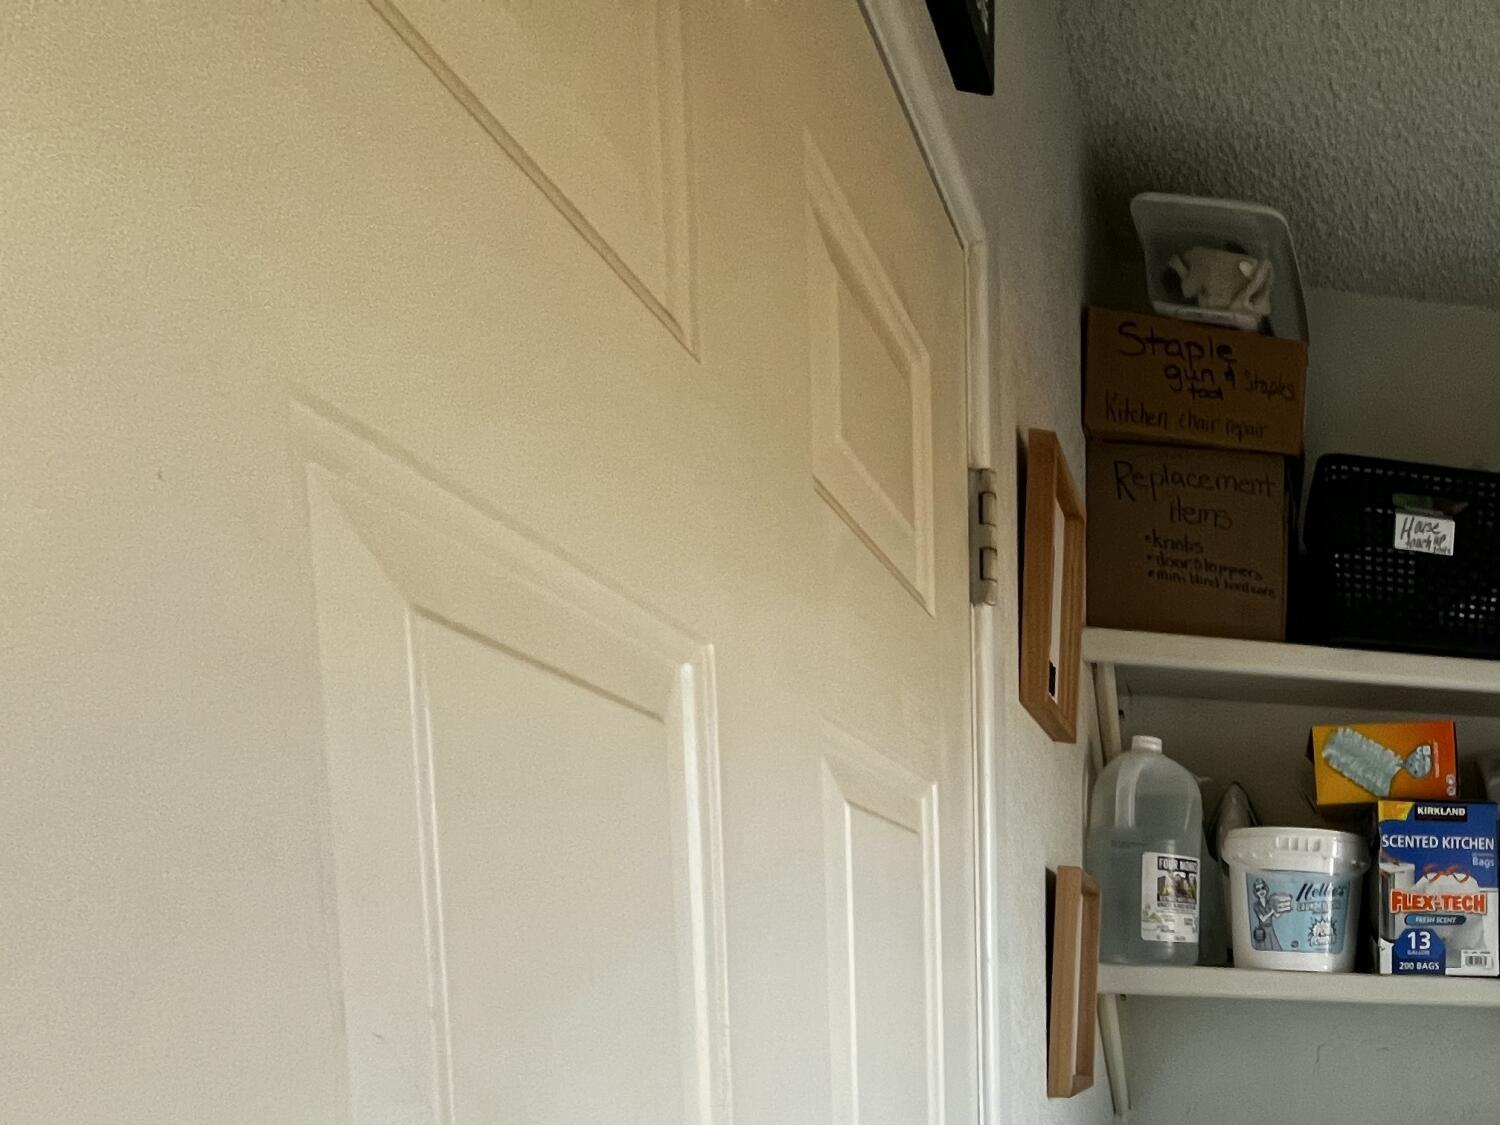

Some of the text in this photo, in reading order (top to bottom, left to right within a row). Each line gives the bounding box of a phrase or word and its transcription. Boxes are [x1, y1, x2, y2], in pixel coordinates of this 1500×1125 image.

[1118, 321, 1233, 369] Staple
[1164, 363, 1215, 392] gun
[1105, 389, 1168, 429] Kitchen
[1179, 409, 1219, 432] chair
[1113, 460, 1276, 501] Replacement
[1417, 806, 1466, 817] KIRKLAND
[1382, 834, 1494, 850] SCENTED KITCHEN
[1472, 857, 1494, 868] Bags
[1296, 883, 1346, 901] Nelle's
[1391, 889, 1487, 914] FLEX-TECH
[1407, 931, 1431, 950] 13
[1399, 962, 1440, 970] 200 BAGS
